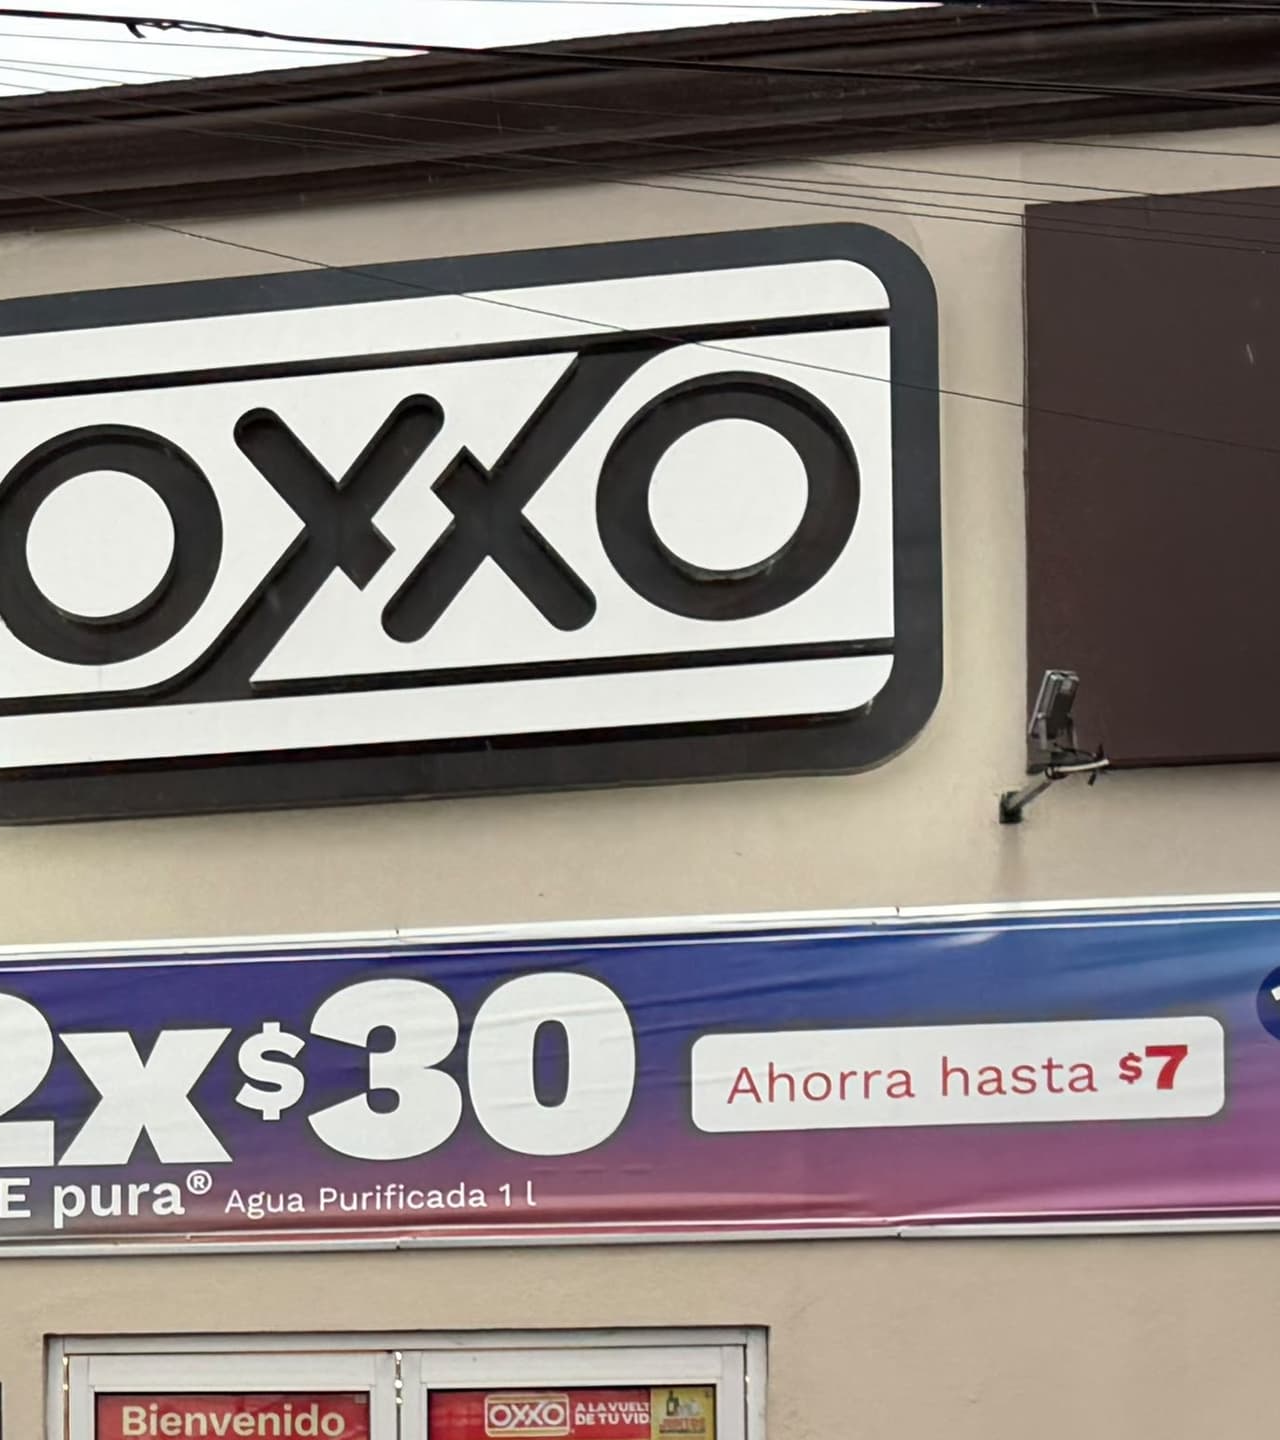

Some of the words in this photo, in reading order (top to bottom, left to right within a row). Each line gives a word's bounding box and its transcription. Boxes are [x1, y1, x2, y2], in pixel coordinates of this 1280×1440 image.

[726, 1062, 916, 1105] Ahorra
[940, 1055, 1099, 1098] hasta
[1117, 1044, 1189, 1091] $7
[224, 1187, 306, 1221] Agua
[319, 1180, 488, 1214] Purificada
[499, 1182, 512, 1209] 1
[121, 1402, 346, 1438] Bienvenido
[488, 1401, 566, 1430] OXXO
[575, 1402, 586, 1413] A
[589, 1402, 607, 1413] LA
[608, 1401, 650, 1413] VUELT
[575, 1413, 596, 1425] DE
[600, 1413, 620, 1425] TU
[621, 1412, 650, 1425] VID
